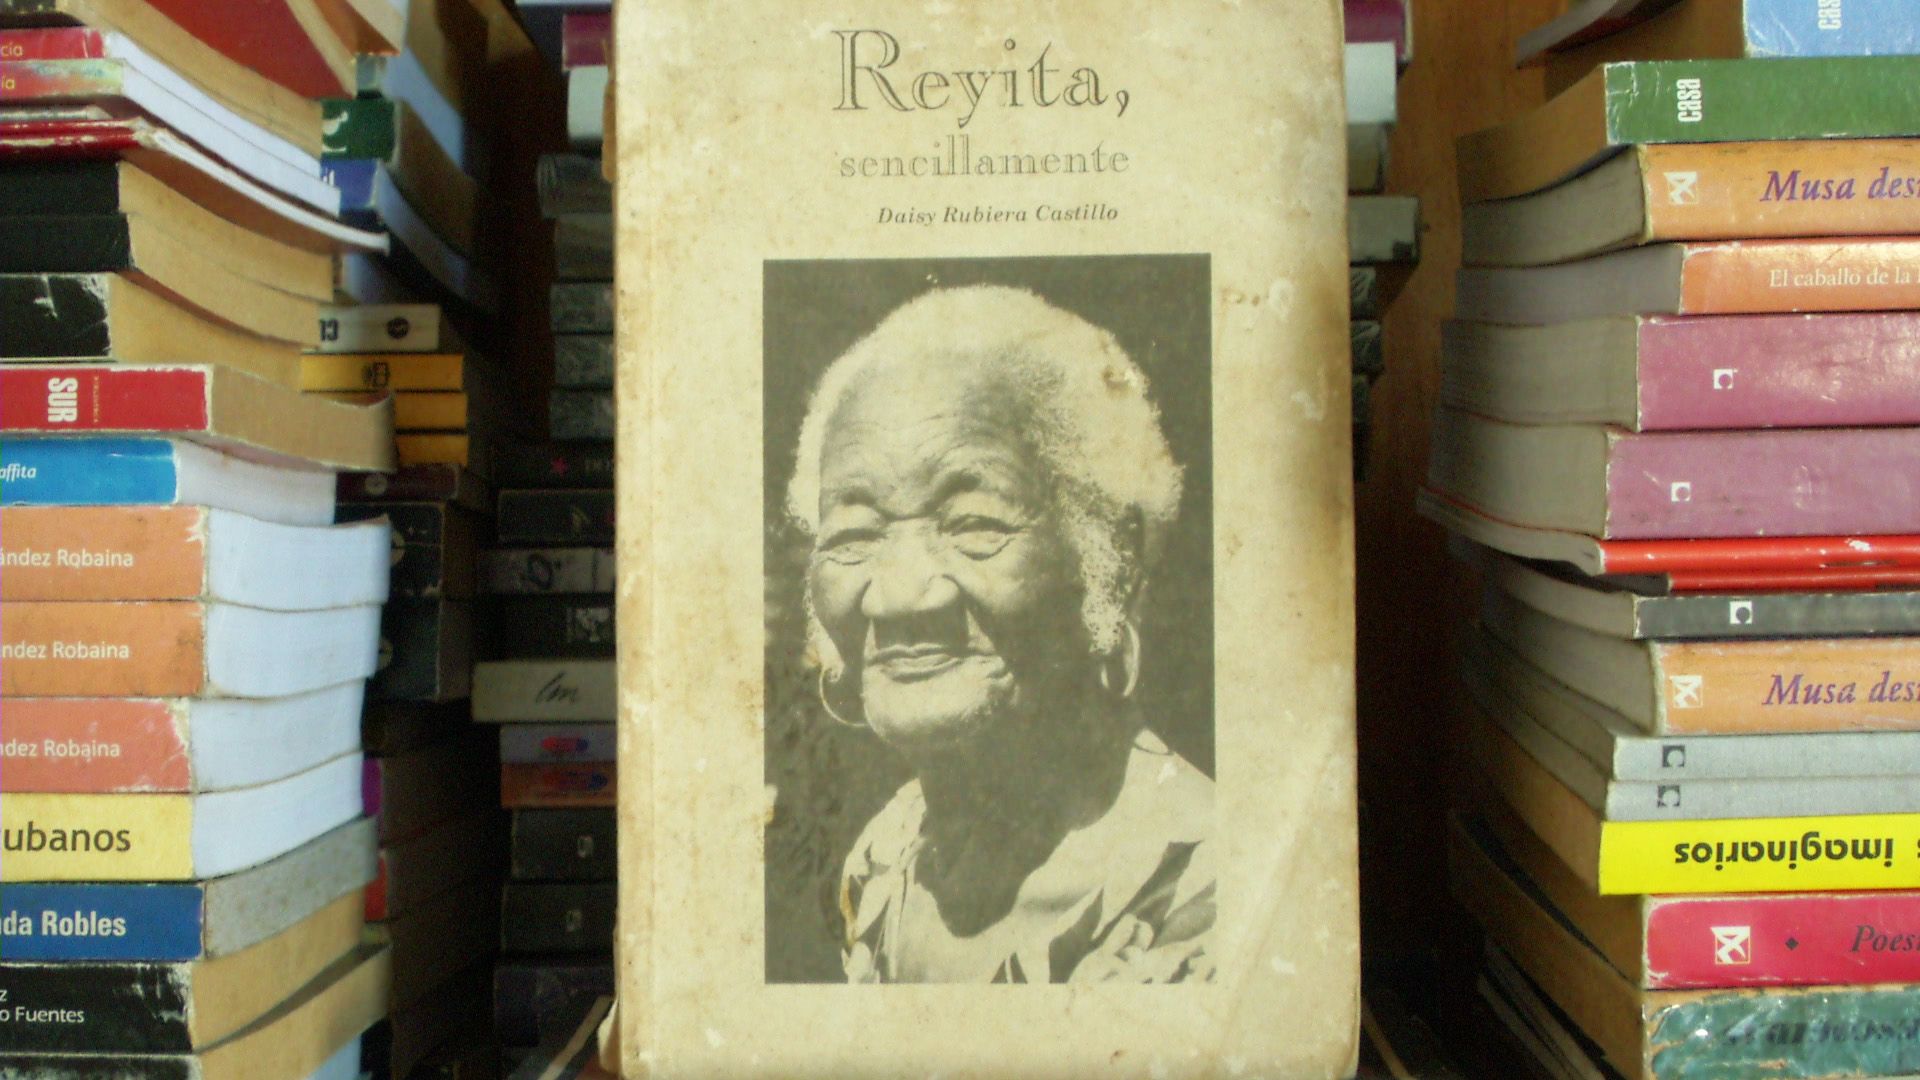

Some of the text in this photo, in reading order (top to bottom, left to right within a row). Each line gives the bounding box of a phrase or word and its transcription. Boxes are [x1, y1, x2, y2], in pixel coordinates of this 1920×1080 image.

[831, 29, 1130, 129] Reyita,
[1676, 78, 1703, 122] casa
[839, 134, 1130, 178] sencillamente
[1759, 169, 1856, 202] Musa
[877, 204, 1119, 226] Daisy Rubiera Castillo
[1769, 266, 1911, 288] El caballo de la
[47, 377, 79, 423] SUR
[57, 547, 135, 568] Robaina
[52, 640, 130, 659] Robaina
[1761, 673, 1857, 706] Musa
[0, 738, 121, 759] dez Robaina
[3, 820, 132, 852] ubanos
[1674, 831, 1893, 871] imaginarios
[0, 910, 127, 936] da Robles
[15, 1006, 85, 1023] Fuentes
